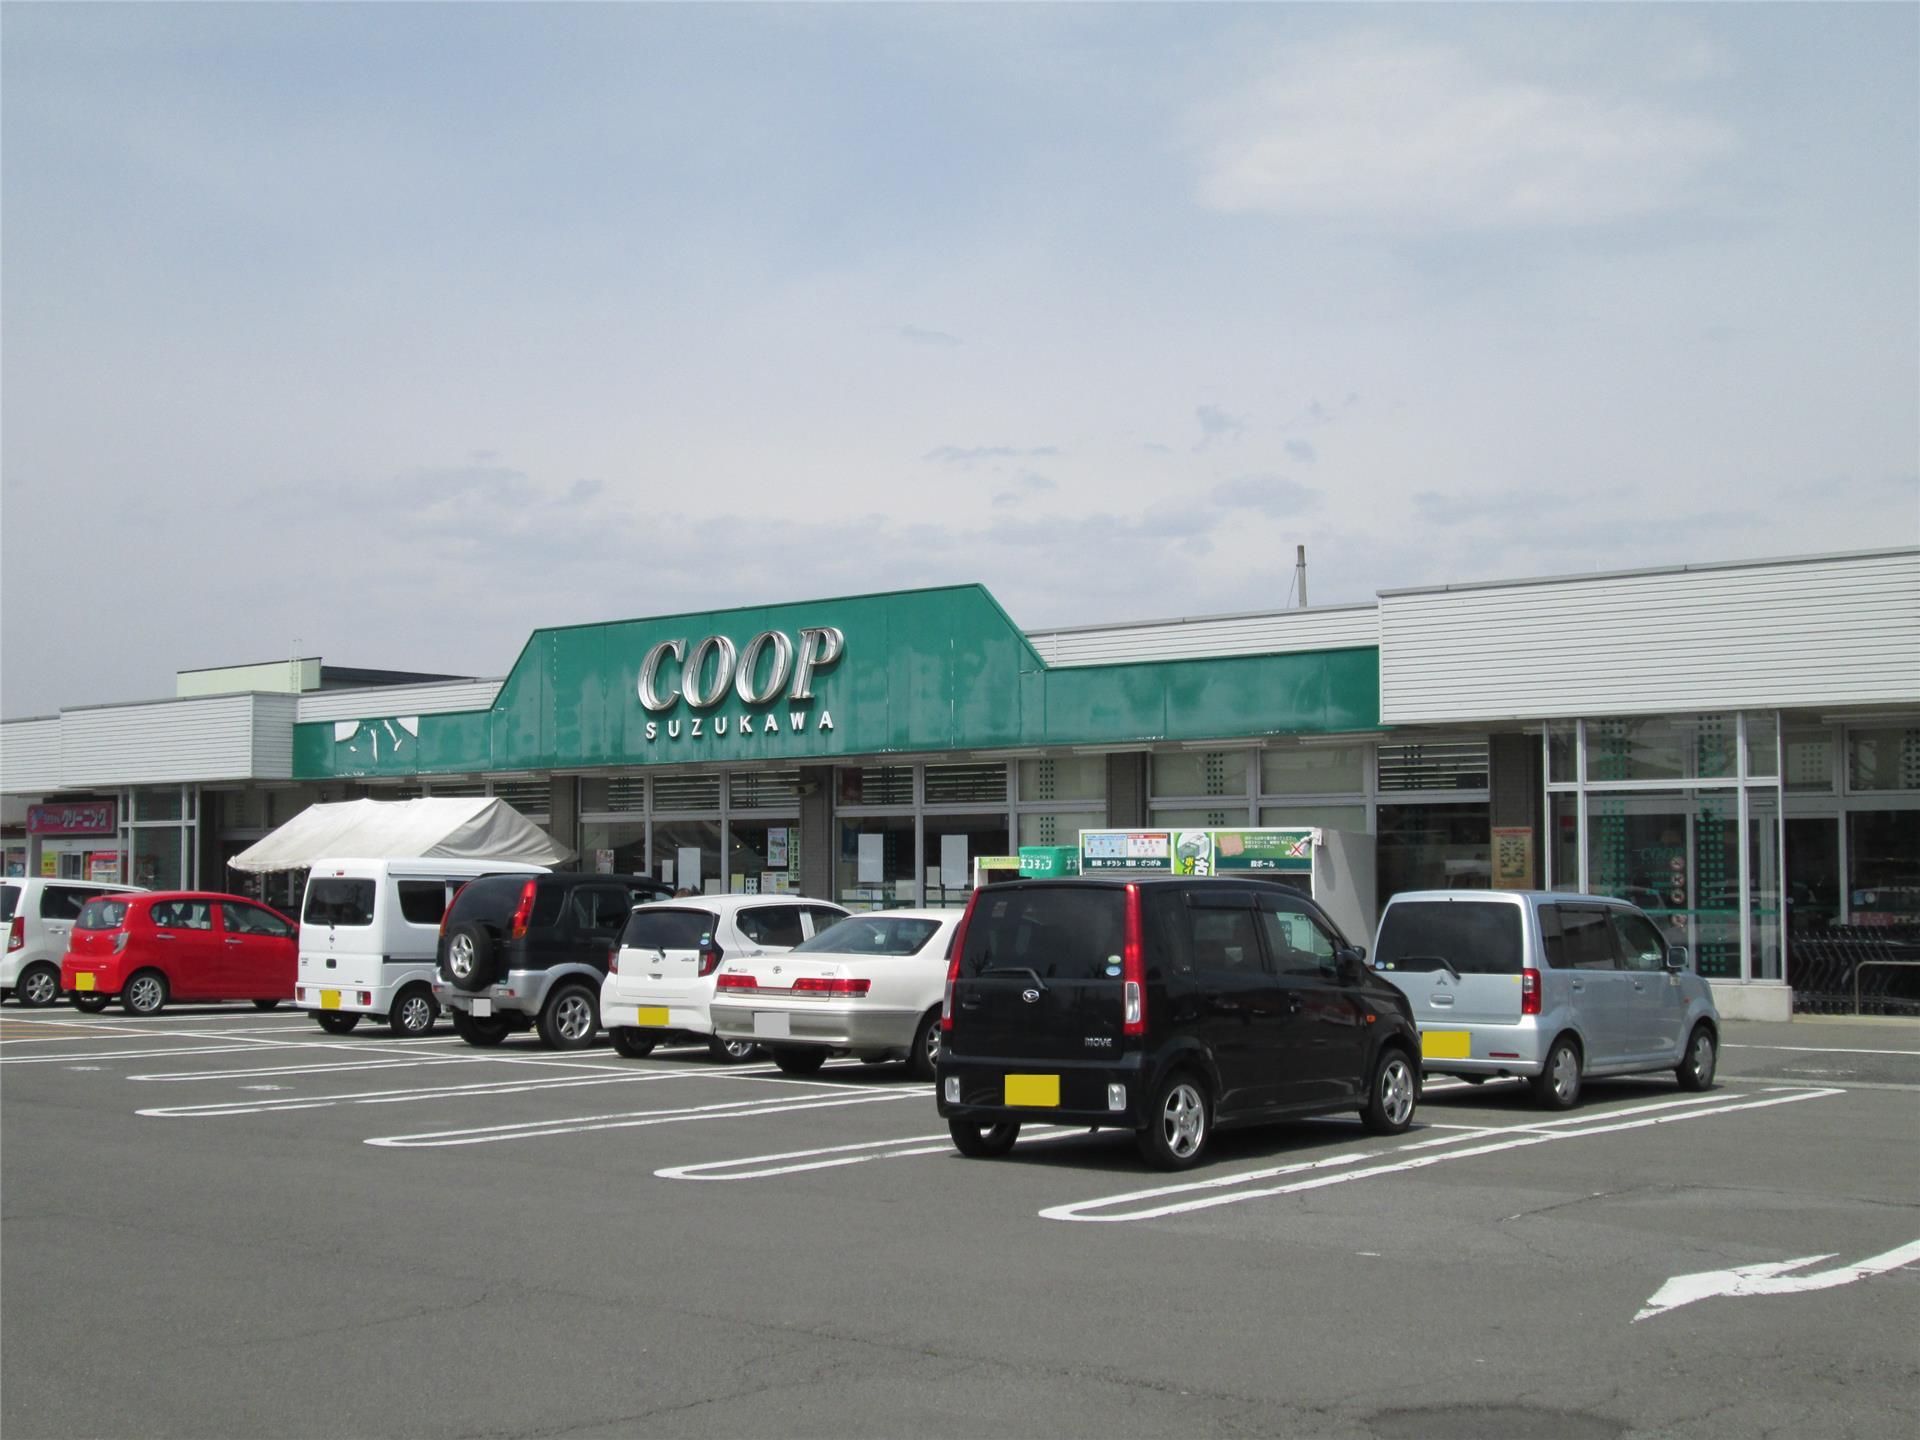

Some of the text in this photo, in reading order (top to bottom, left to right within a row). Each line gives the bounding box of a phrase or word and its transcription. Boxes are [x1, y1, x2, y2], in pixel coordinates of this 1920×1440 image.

[637, 627, 845, 711] COOP
[645, 711, 834, 740] SUZUKAWA
[62, 808, 107, 828] クリーニング
[1084, 1037, 1112, 1047] MOVE
